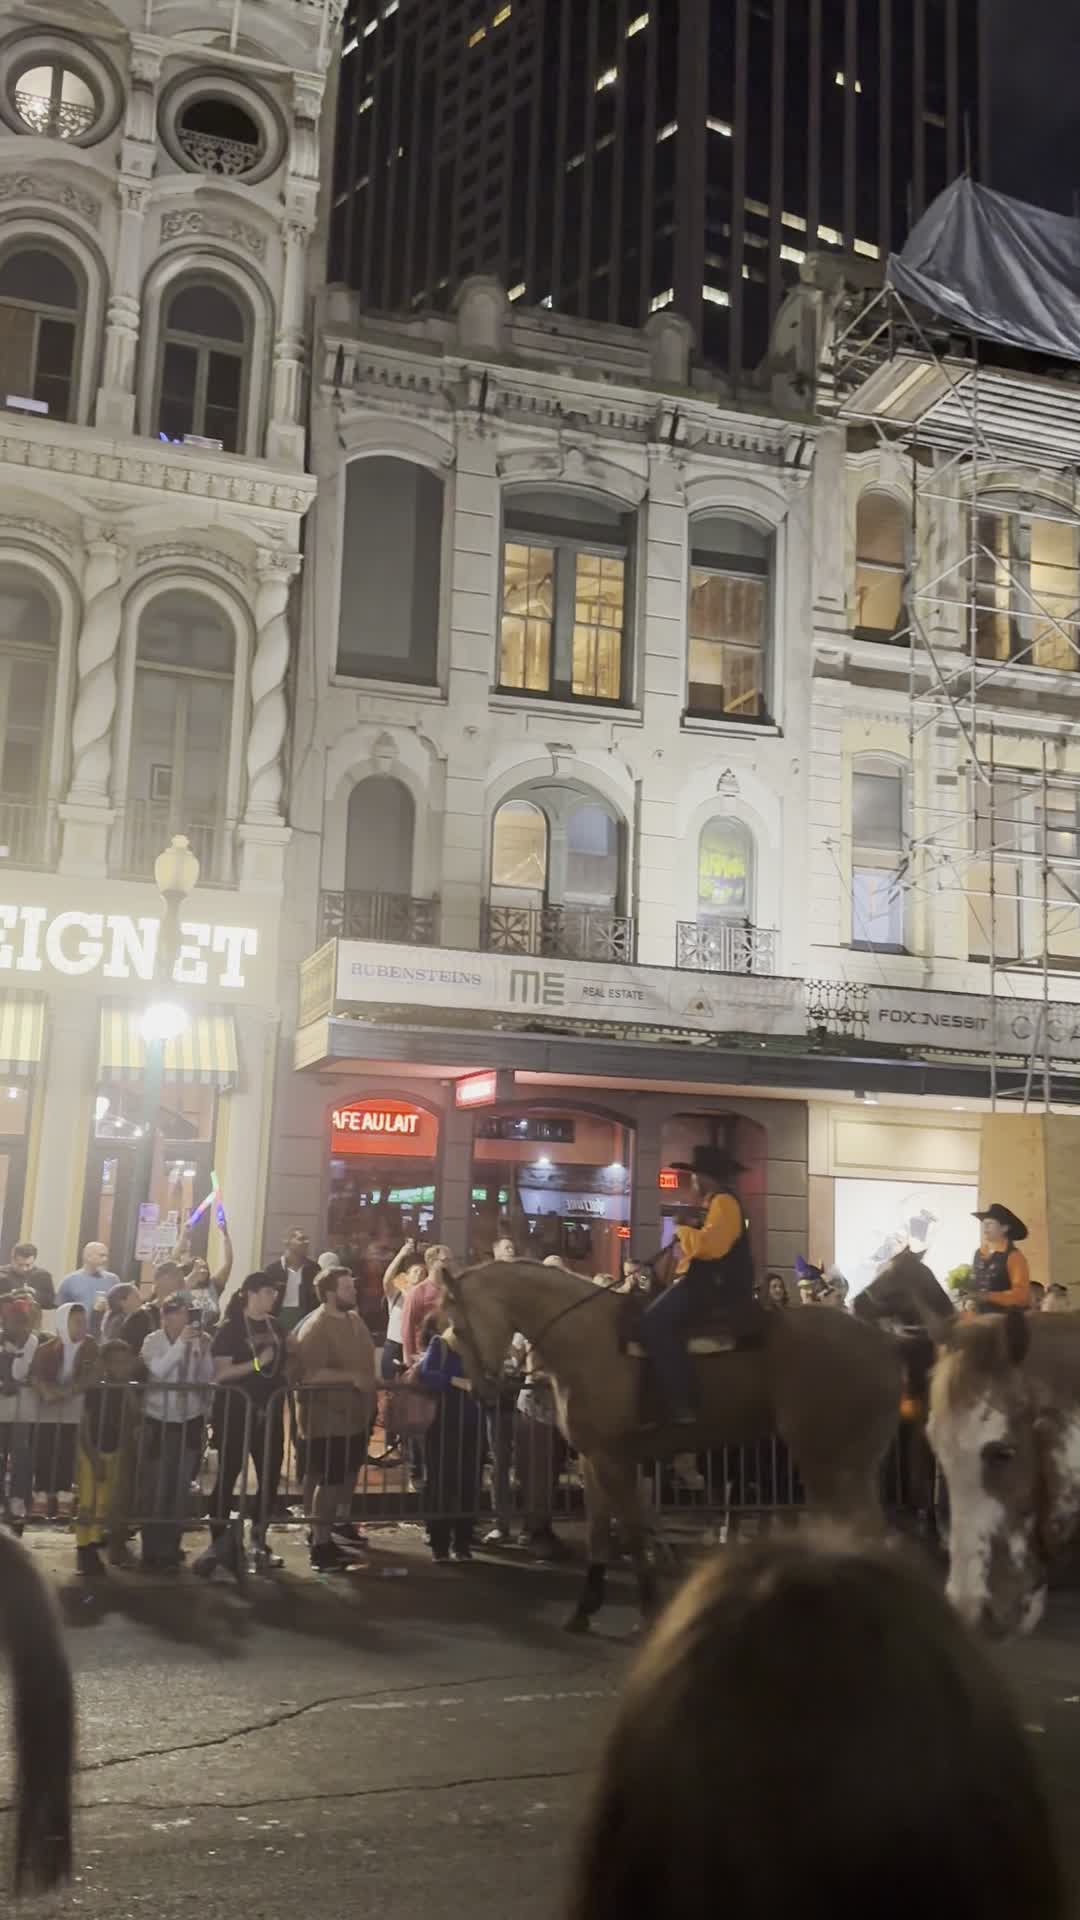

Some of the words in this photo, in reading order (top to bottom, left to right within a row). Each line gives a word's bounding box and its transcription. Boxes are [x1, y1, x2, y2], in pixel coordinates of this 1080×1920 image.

[351, 961, 482, 986] RUBENSTEINS
[583, 986, 606, 998] REAL
[609, 988, 645, 1001] ESTATE
[385, 1113, 419, 1133] LAIT
